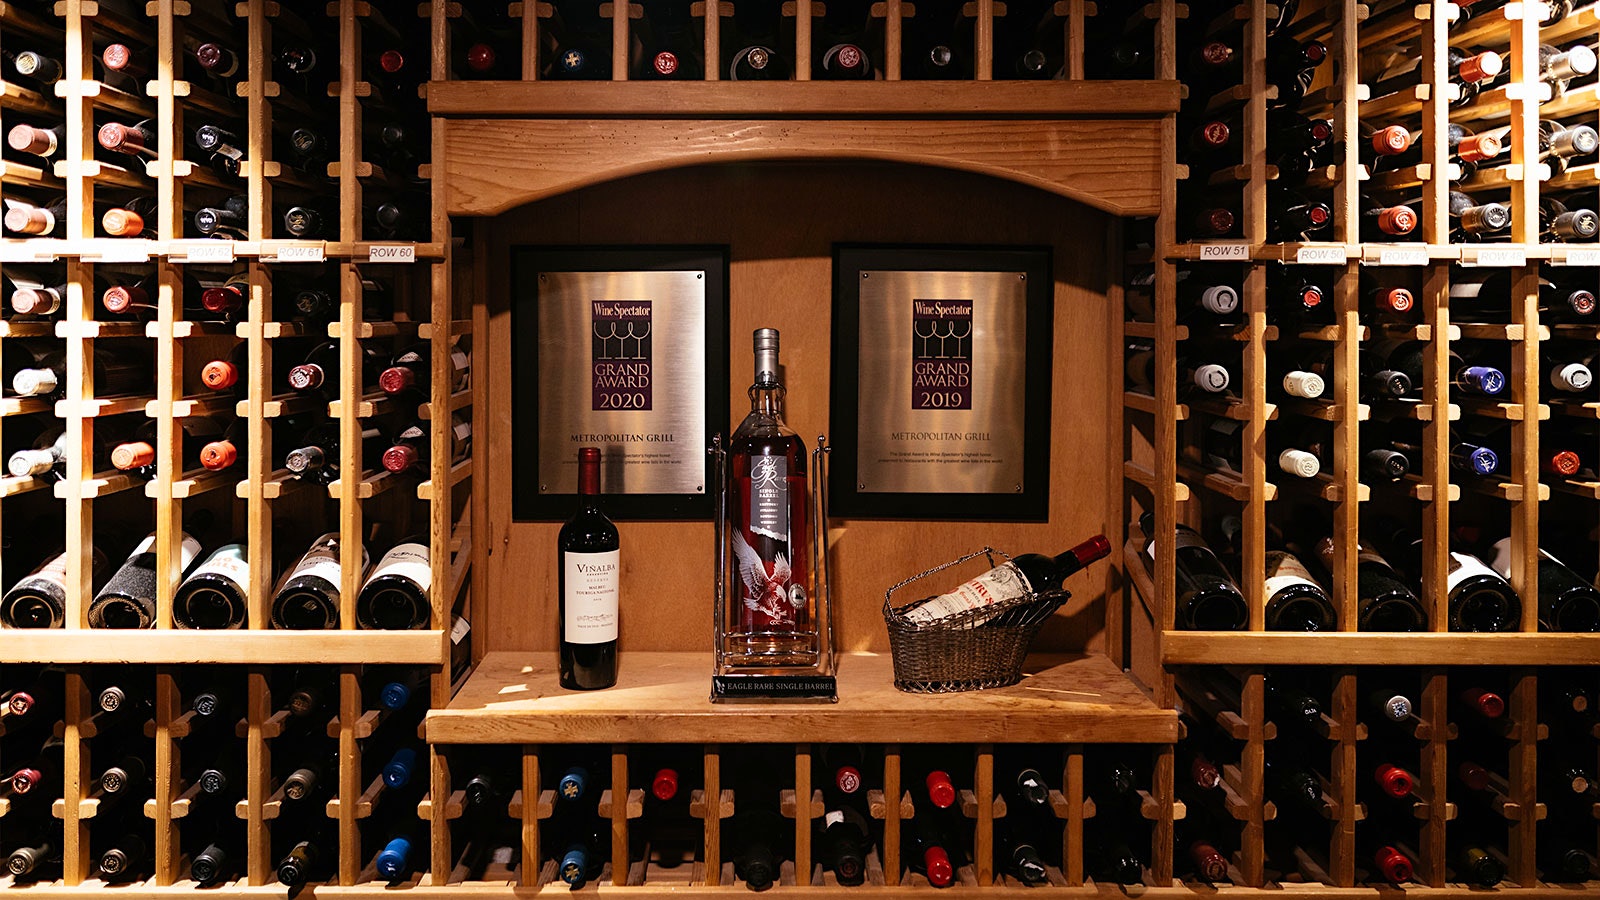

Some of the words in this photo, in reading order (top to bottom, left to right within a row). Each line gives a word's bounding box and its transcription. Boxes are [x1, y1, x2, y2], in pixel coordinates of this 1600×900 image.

[188, 247, 215, 257] ROW
[279, 247, 305, 257] ROW
[308, 247, 320, 257] 61
[370, 247, 397, 258] ROW
[399, 247, 413, 257] 60
[1204, 246, 1231, 256] ROW
[1234, 246, 1245, 255] 51
[1301, 249, 1328, 259] ROW
[1331, 249, 1343, 259] 50
[1383, 250, 1410, 261] ROW
[1480, 250, 1507, 261] ROW
[1569, 250, 1595, 261] ROW
[594, 302, 614, 316] Wine
[614, 302, 651, 320] Spectator
[915, 301, 935, 315] Wine
[935, 301, 972, 319] Spectator
[594, 363, 650, 376] GRAND
[915, 362, 970, 375] GRAND
[594, 375, 650, 388] AWARD
[915, 374, 969, 387] AWARD
[600, 392, 646, 409] 2020
[920, 391, 963, 408] 2019
[570, 433, 644, 443] METROPOLITAN
[646, 433, 675, 443] GRILL
[891, 431, 962, 441] METROPOLITAN
[964, 431, 992, 441] GRILL
[576, 563, 616, 573] VIÑALBA
[727, 682, 753, 690] EAGLE
[754, 682, 774, 690] RARE
[775, 682, 803, 690] SINGLE
[804, 682, 835, 690] BARREL
